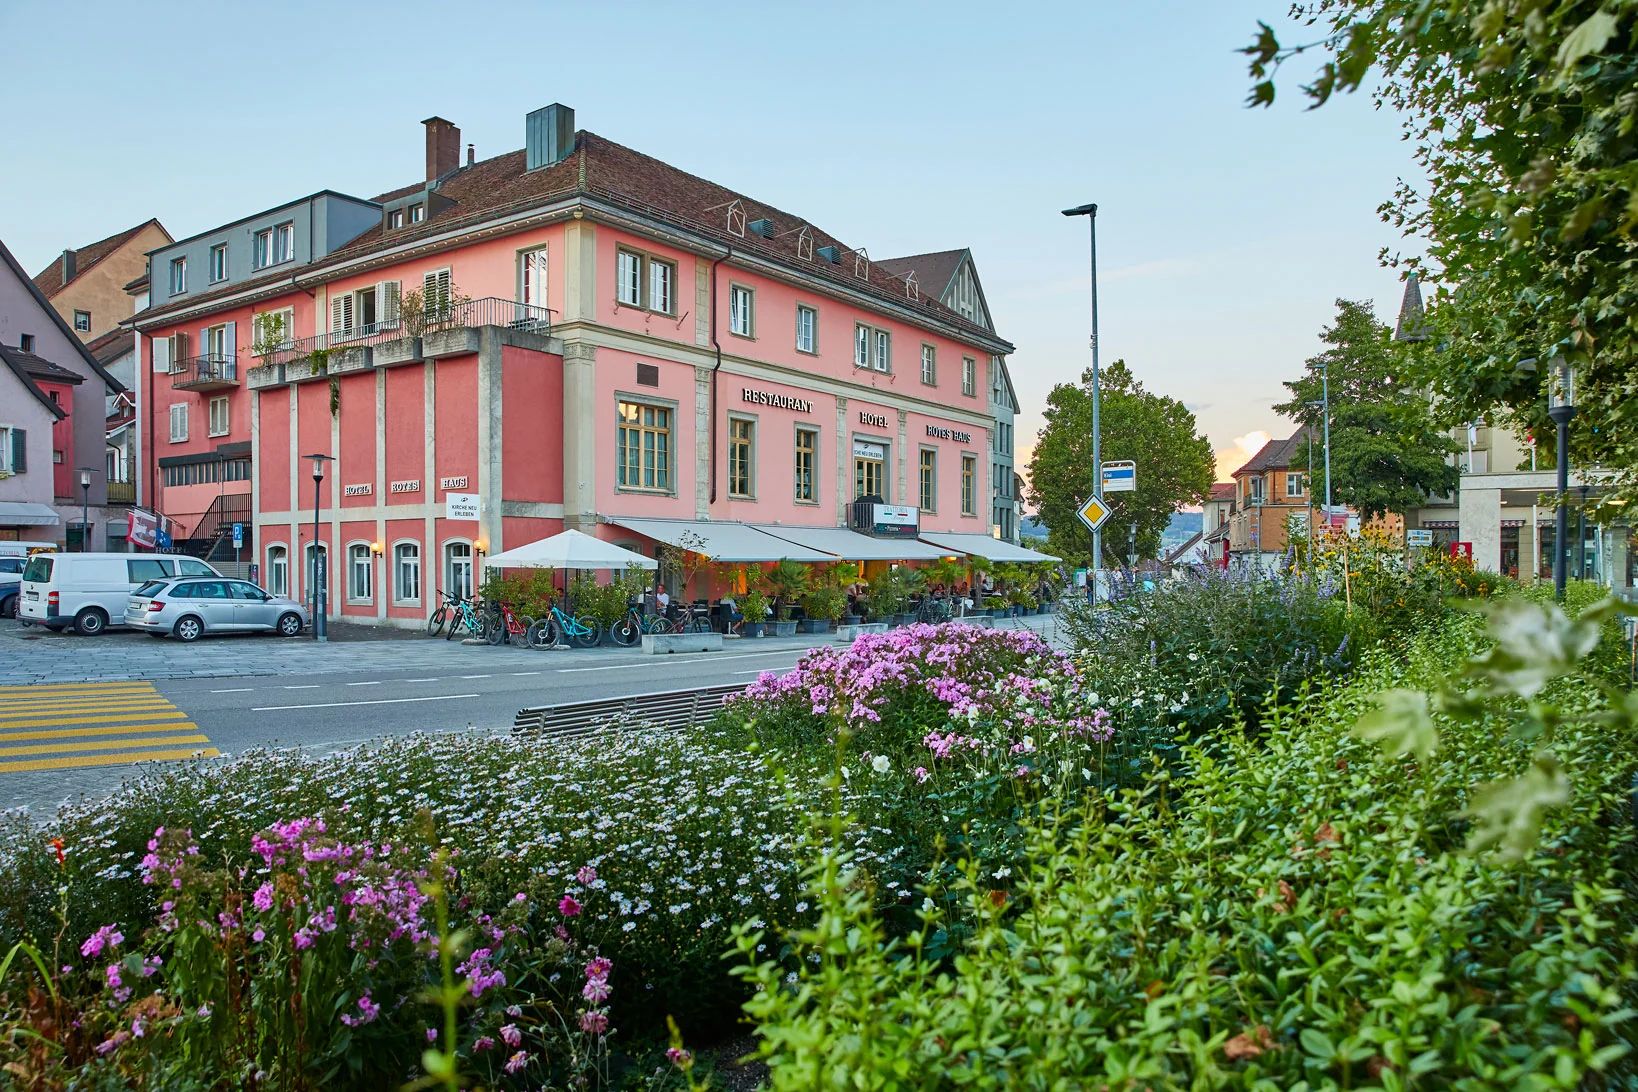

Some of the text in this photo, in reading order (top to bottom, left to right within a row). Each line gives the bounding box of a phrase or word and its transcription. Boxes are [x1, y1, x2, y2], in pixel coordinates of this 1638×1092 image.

[742, 388, 814, 413] RESTAURANT
[860, 412, 889, 428] HOTEL
[926, 425, 971, 443] ROTES HAUS
[443, 478, 467, 488] HAUS
[346, 486, 370, 494] HOTEL
[155, 546, 192, 554] HOTEL
